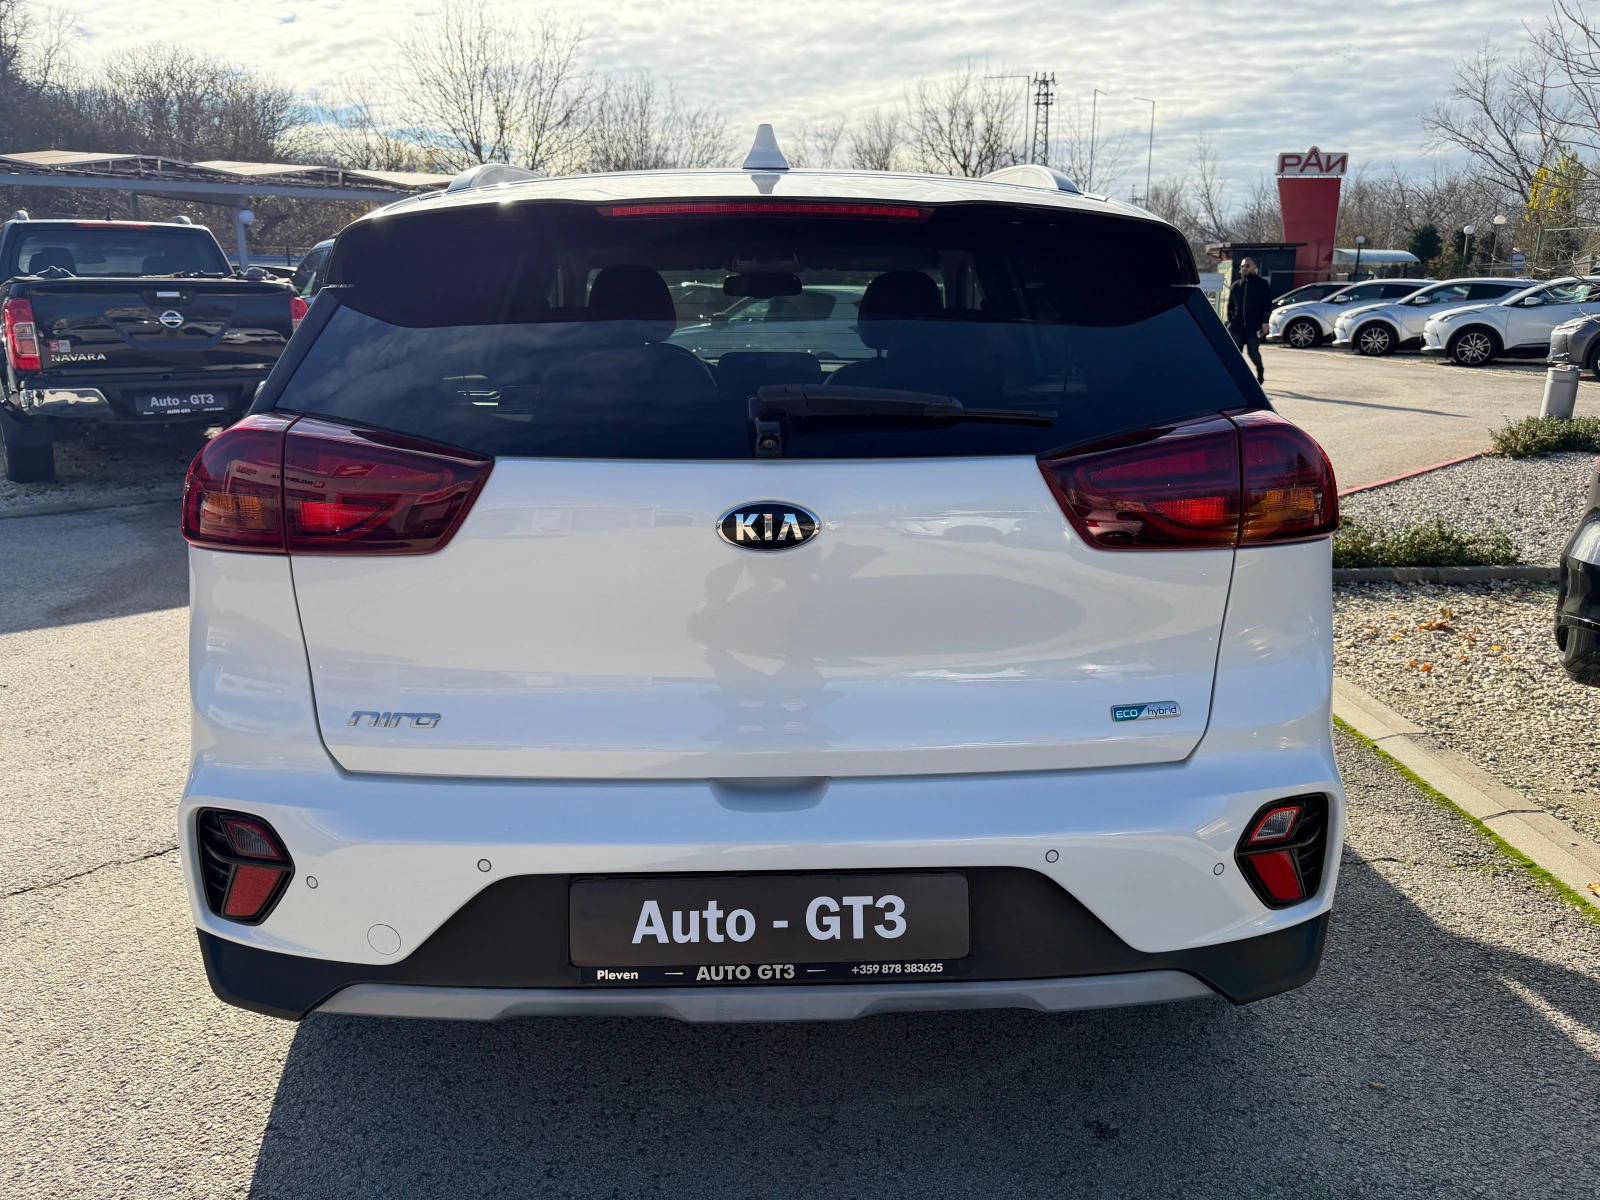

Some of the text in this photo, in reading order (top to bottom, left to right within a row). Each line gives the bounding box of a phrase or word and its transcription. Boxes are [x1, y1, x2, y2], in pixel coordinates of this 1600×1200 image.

[51, 353, 106, 362] NAVARA
[150, 396, 180, 407] Auto
[190, 394, 214, 405] GT3
[734, 513, 804, 541] KIA
[1116, 705, 1177, 718] ECO hybrid
[631, 900, 756, 944] Auto
[805, 894, 907, 940] GT3
[596, 962, 943, 981] Pleven AUTO GT3 +359 878 383625
